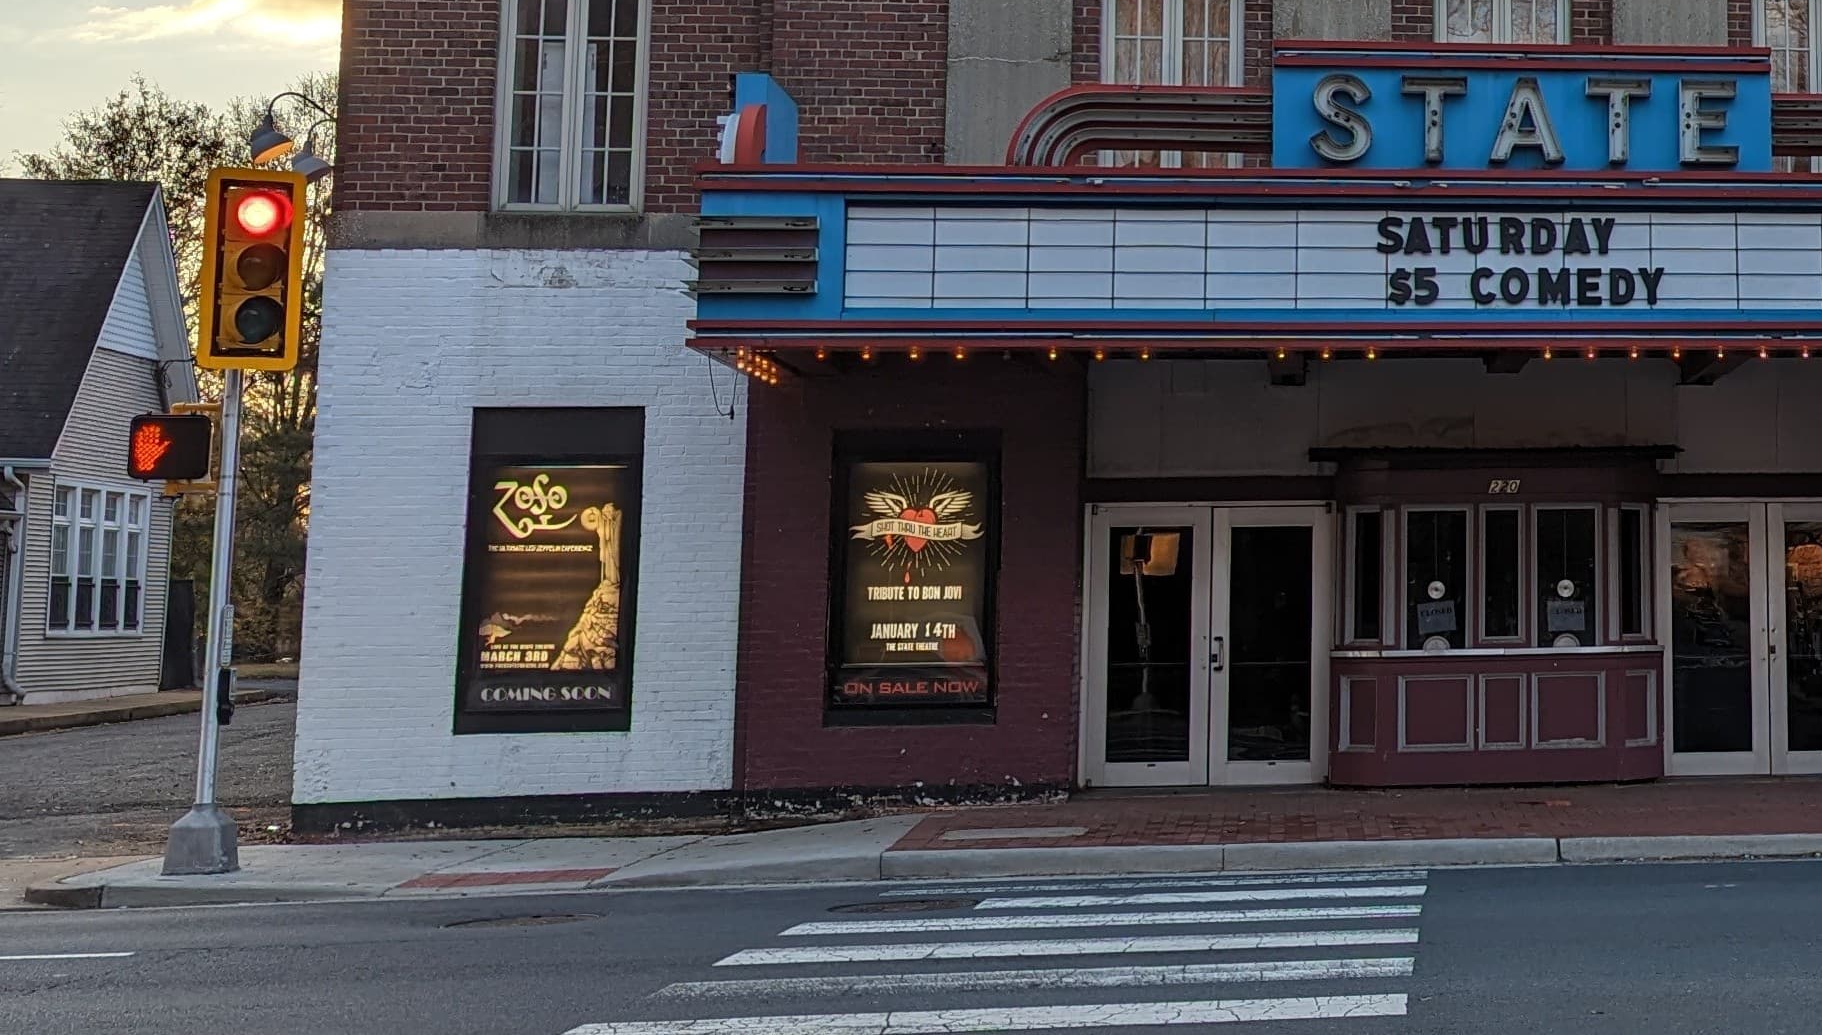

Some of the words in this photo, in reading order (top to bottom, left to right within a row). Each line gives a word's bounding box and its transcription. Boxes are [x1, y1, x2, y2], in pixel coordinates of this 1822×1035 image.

[1308, 74, 1740, 164] STATE
[1377, 217, 1615, 255] SATURDAY
[1388, 267, 1440, 306] $5
[1470, 267, 1664, 306] COMEDY
[876, 521, 895, 533] SHOT
[897, 522, 916, 534] THRU
[918, 525, 931, 537] THE
[933, 526, 957, 538] HEART
[867, 586, 904, 600] TRIBUTE
[907, 586, 920, 600] TO
[922, 586, 941, 600] BON
[943, 586, 962, 600] JOVI
[870, 623, 919, 639] JANUARY
[886, 643, 896, 652] THE
[480, 650, 522, 662] MARCH
[524, 650, 548, 662] 3RD
[480, 686, 557, 702] COMING
[560, 686, 612, 700] SOON
[844, 682, 872, 694] ON
[878, 682, 928, 694] SALE
[934, 681, 978, 694] NOW
